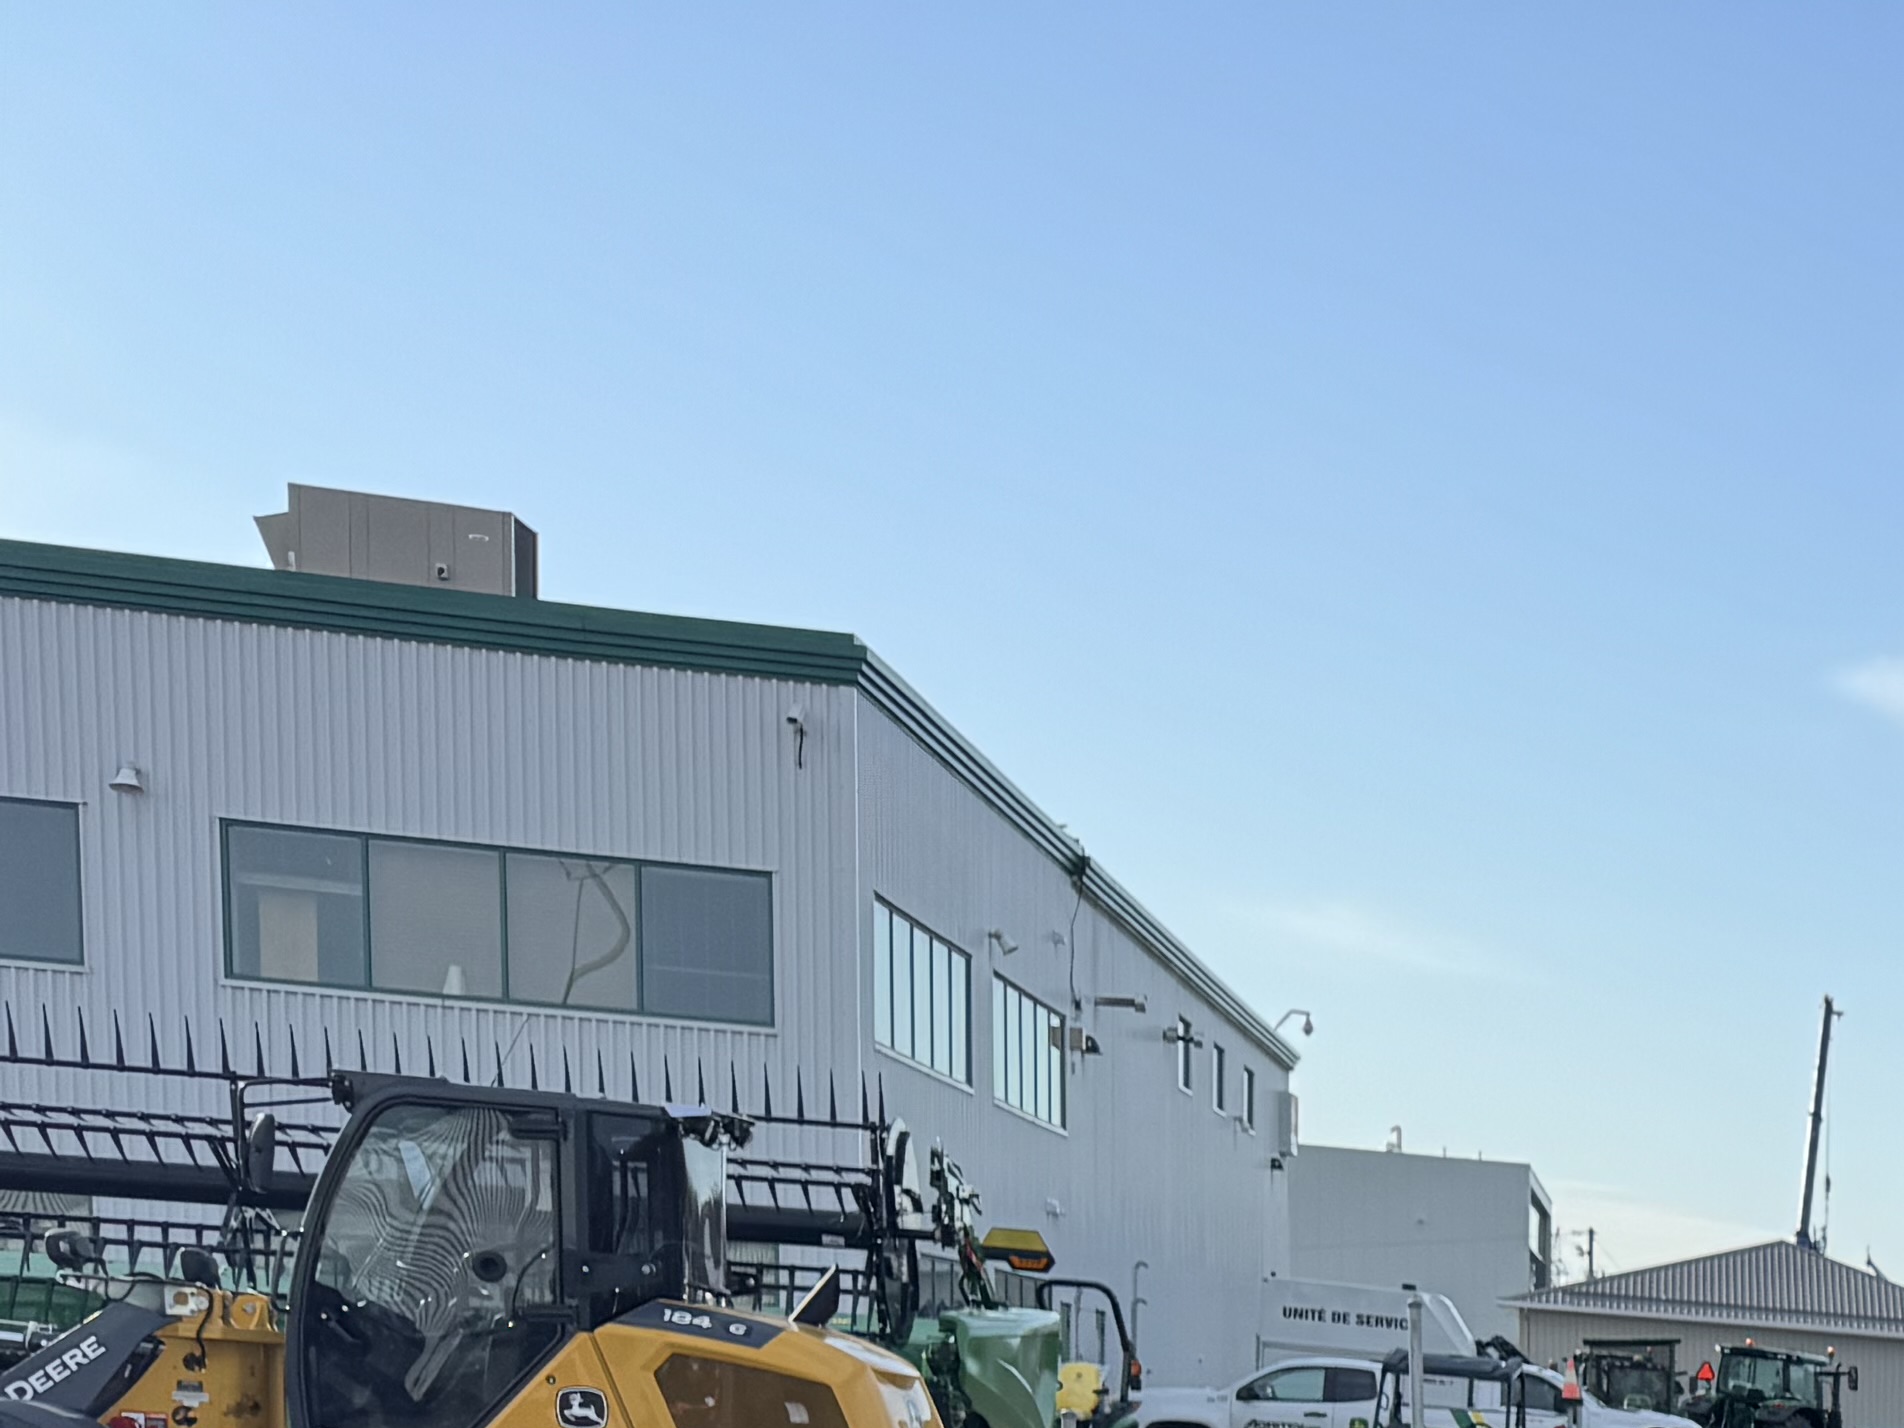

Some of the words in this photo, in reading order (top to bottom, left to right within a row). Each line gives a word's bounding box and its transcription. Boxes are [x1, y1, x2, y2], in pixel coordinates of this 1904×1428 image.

[663, 1308, 713, 1329] 184
[1282, 1305, 1326, 1323] UNITÉ
[1331, 1310, 1351, 1326] DE
[3, 1334, 107, 1401] DEERE
